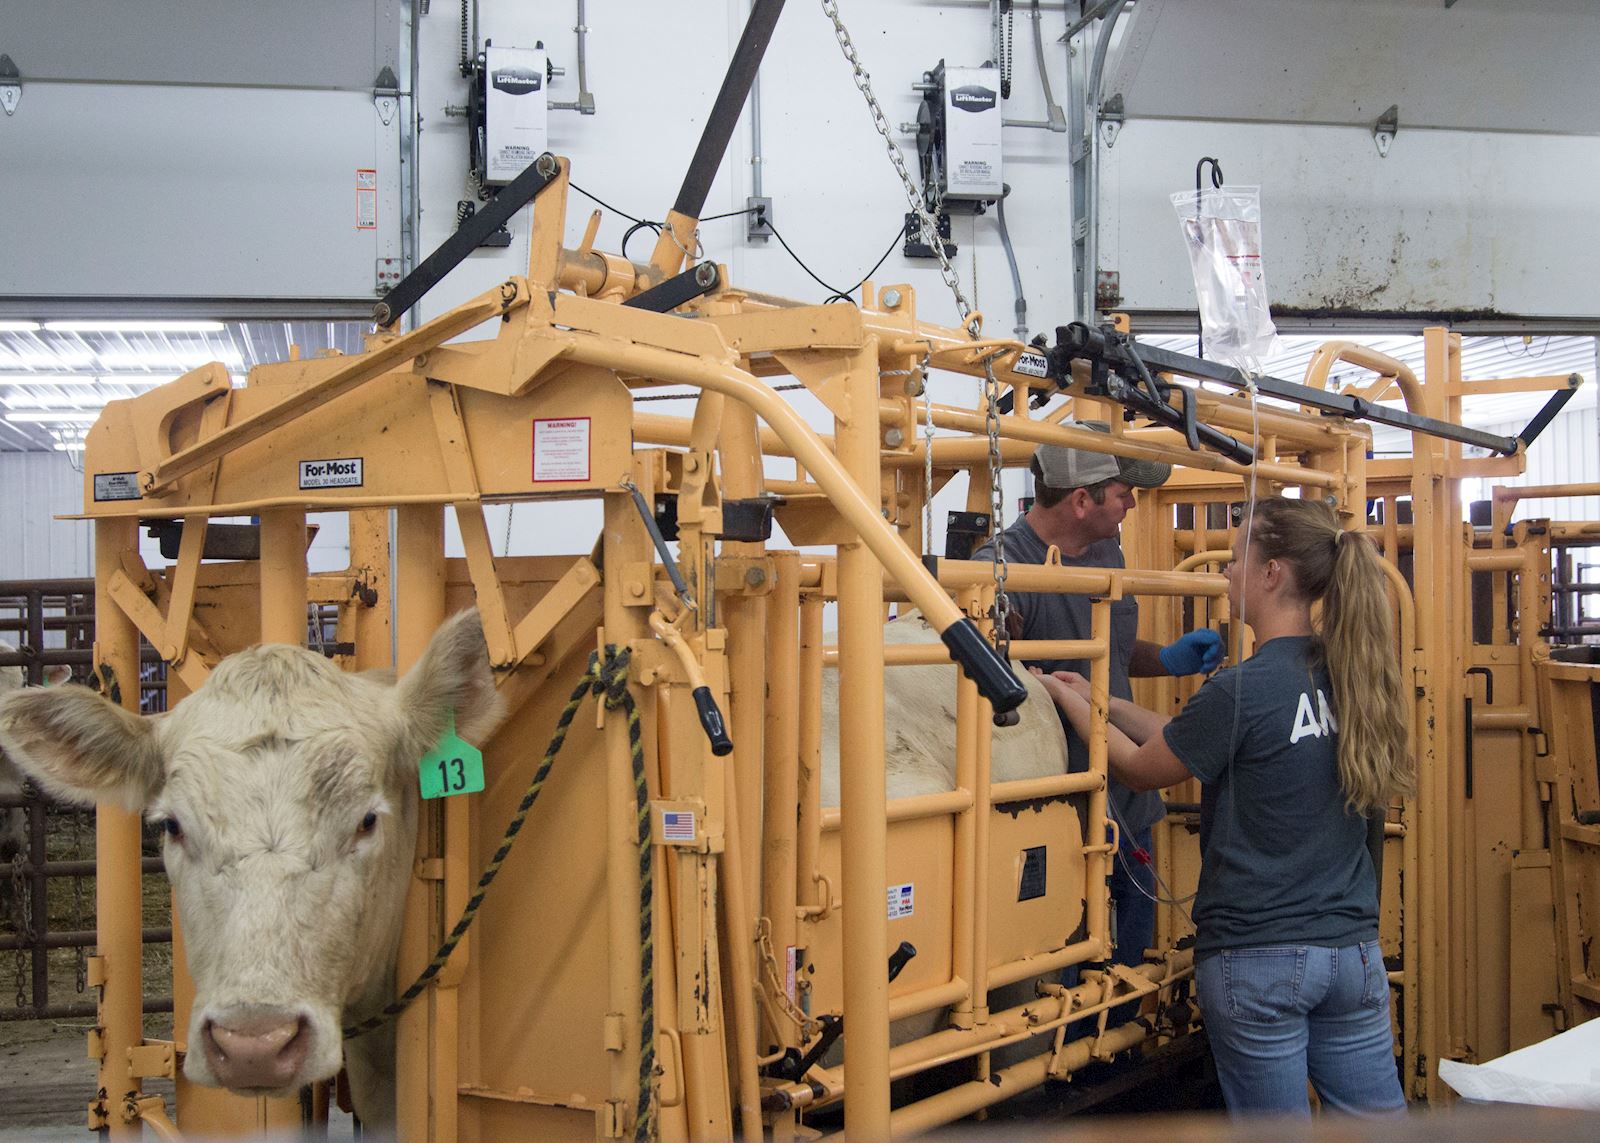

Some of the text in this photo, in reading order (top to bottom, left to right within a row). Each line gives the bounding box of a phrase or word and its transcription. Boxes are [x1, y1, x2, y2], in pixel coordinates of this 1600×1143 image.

[497, 75, 537, 84] LiftMaster
[956, 94, 992, 102] LiftMaster
[438, 758, 466, 793] 13
